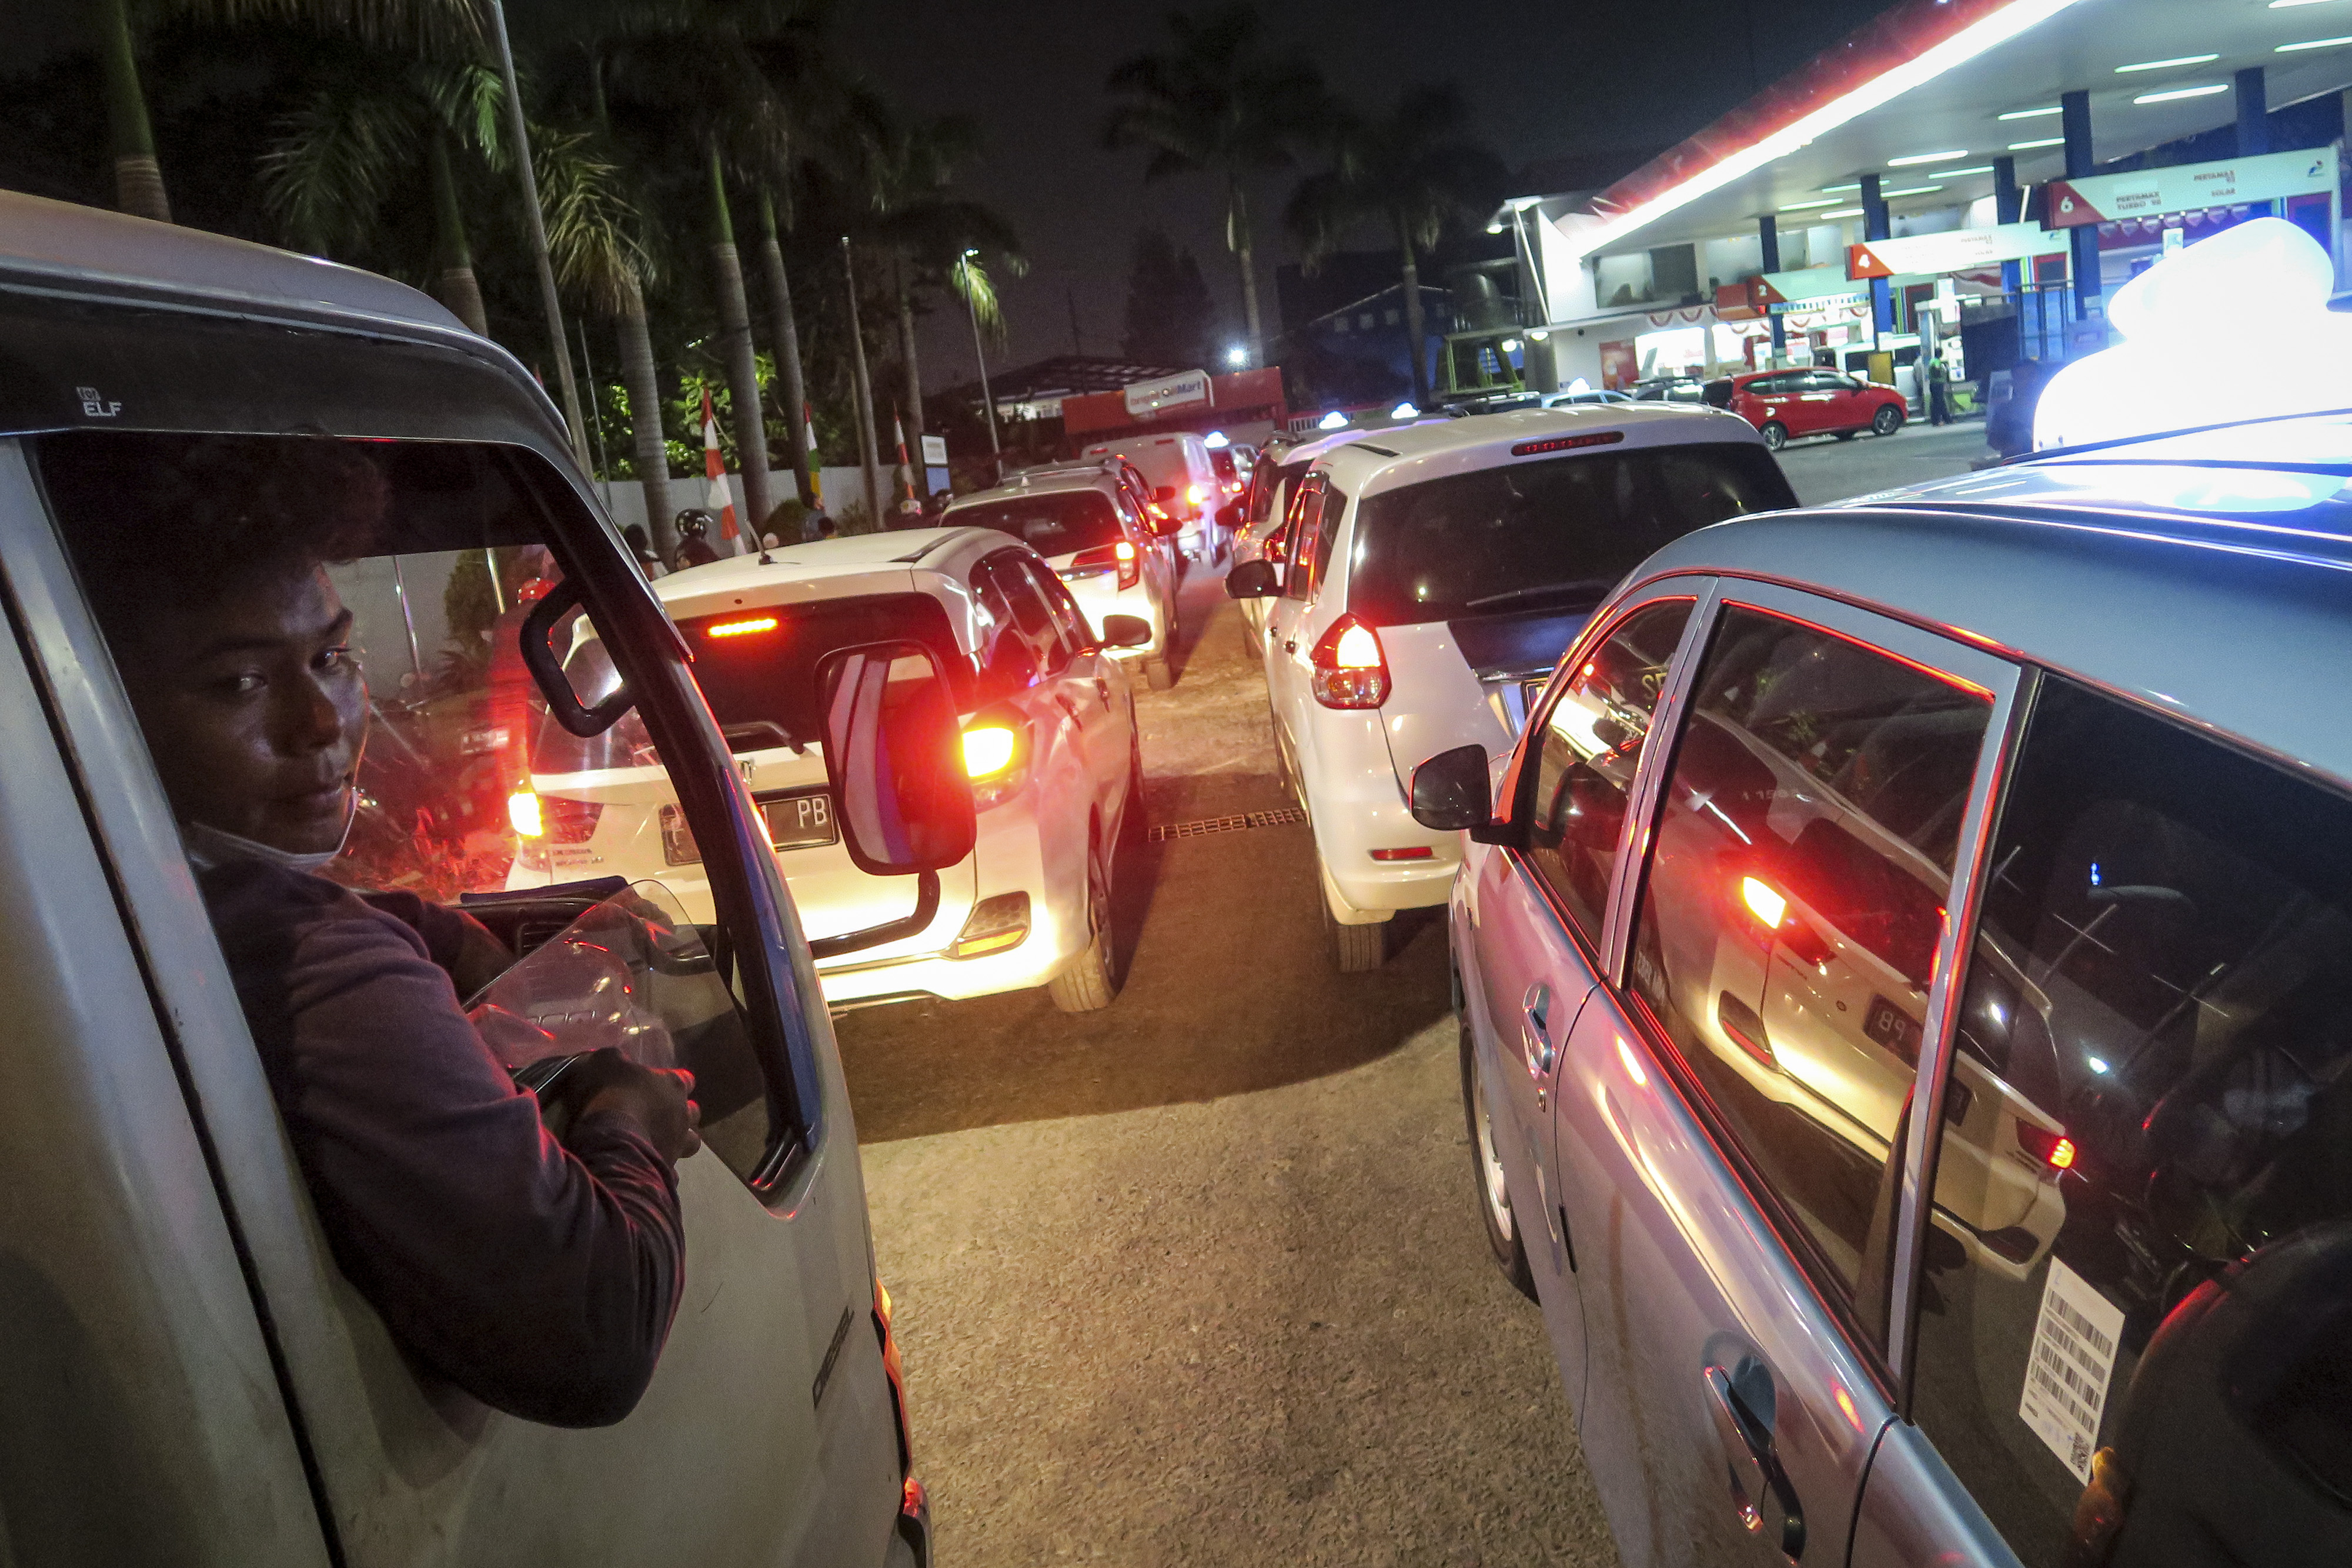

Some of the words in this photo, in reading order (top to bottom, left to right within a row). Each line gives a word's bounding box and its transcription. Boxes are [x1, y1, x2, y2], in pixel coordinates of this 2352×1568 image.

[2060, 196, 2074, 213] 6
[2116, 191, 2160, 203] PERTAMAX
[1858, 253, 1870, 268] 4
[82, 400, 122, 416] ELF
[797, 797, 827, 828] PB
